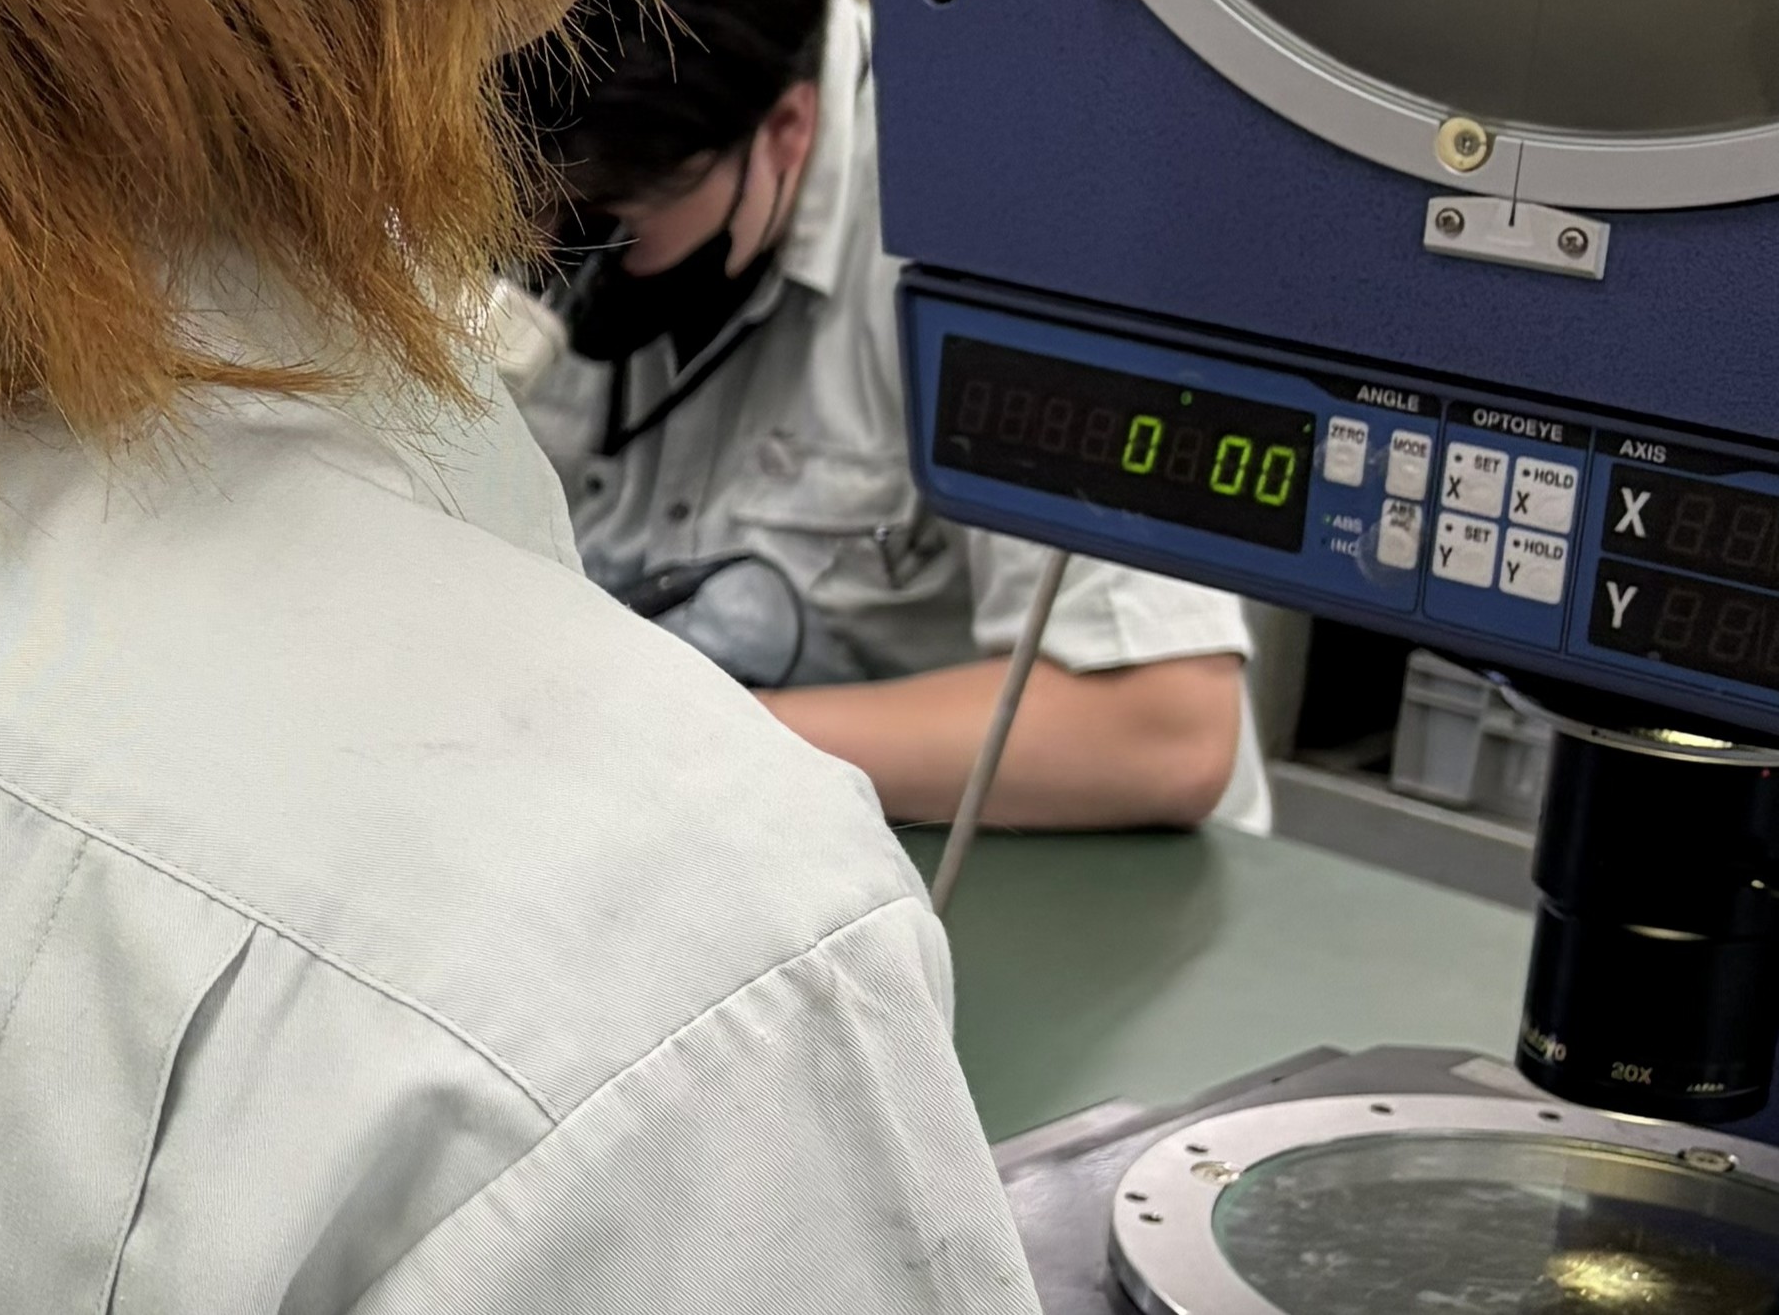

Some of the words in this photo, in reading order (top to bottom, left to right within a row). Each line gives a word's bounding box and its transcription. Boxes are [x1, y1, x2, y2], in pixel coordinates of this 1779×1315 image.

[1356, 385, 1420, 413] ANGLE
[1329, 422, 1366, 445] ZERO
[1472, 408, 1563, 442] OPTOEYE
[1393, 438, 1428, 459] MODE
[1619, 439, 1667, 464] AXIS
[1473, 454, 1503, 474] SET
[1446, 475, 1462, 500] X
[1533, 467, 1575, 490] HOLD
[1513, 490, 1531, 515] X
[1614, 487, 1652, 538] X
[1463, 525, 1492, 545] SET
[1439, 544, 1454, 569] Y
[1523, 538, 1564, 561] HOLD
[1506, 561, 1521, 584] Y
[1606, 581, 1639, 629] Y
[1610, 1061, 1654, 1085] 20X
